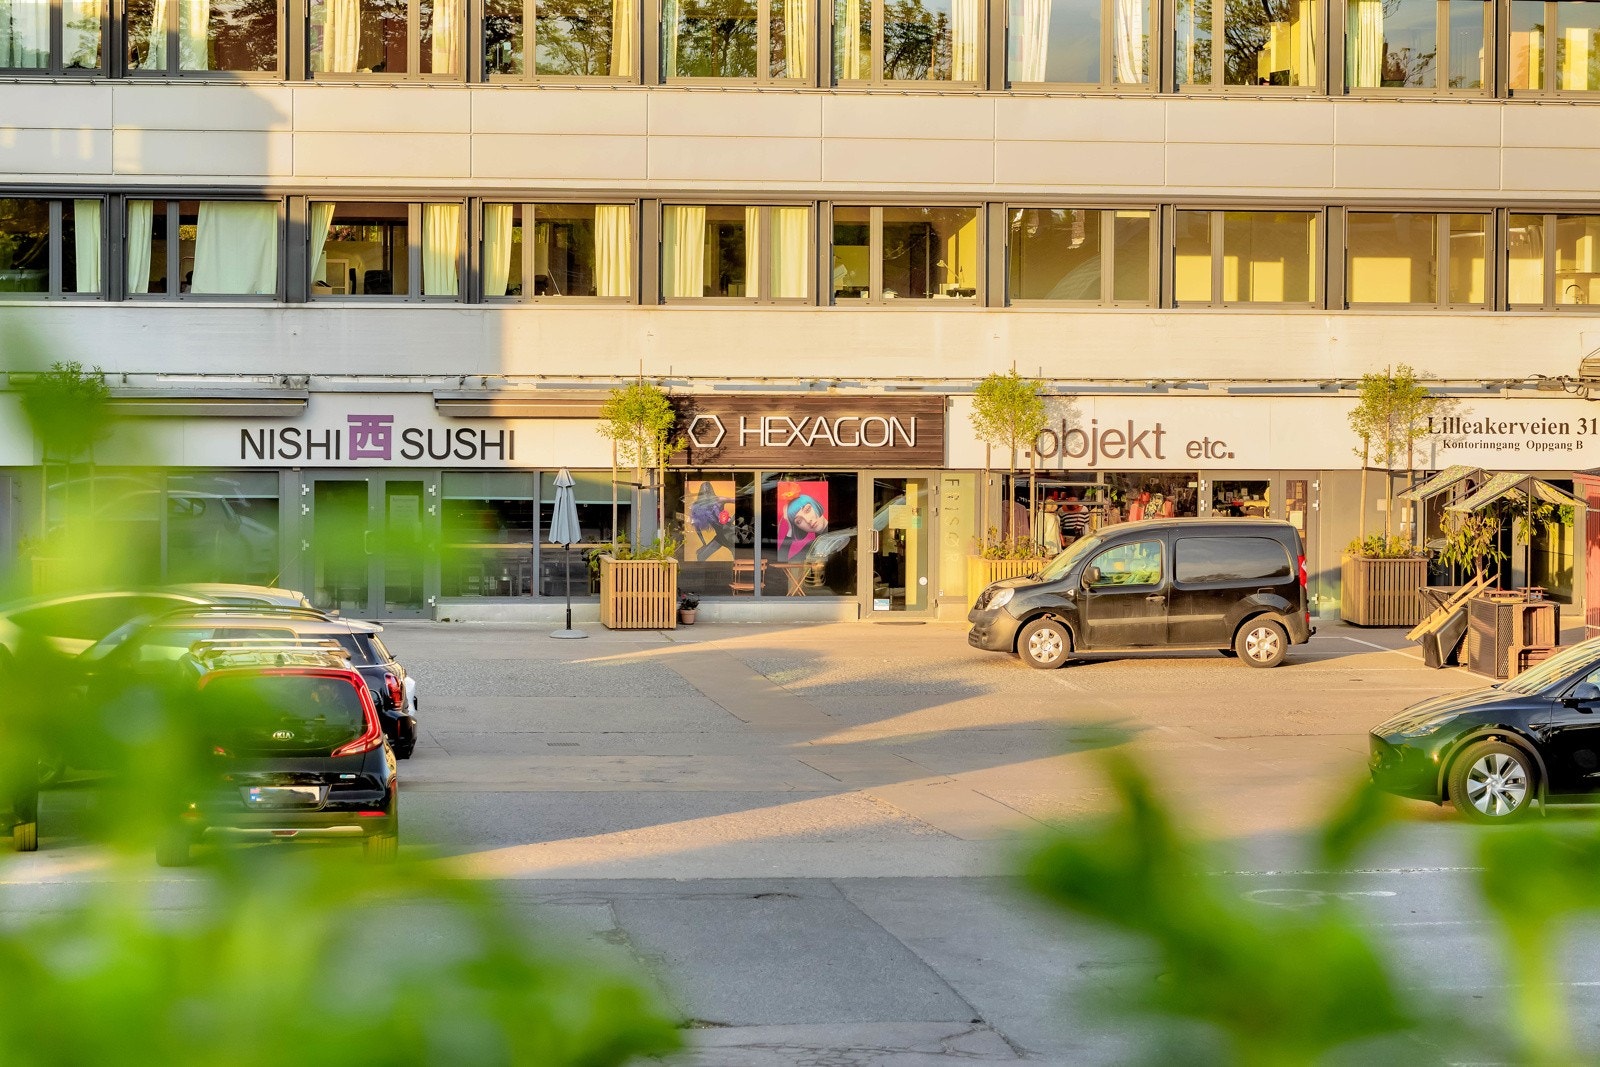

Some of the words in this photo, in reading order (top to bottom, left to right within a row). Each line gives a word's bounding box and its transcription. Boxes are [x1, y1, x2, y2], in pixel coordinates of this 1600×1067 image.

[739, 415, 916, 448] HEXAGON
[1427, 416, 1570, 435] Lilleakerveien
[1576, 417, 1598, 435] 31
[240, 427, 341, 460] NISHI
[347, 414, 394, 461] 西
[400, 427, 515, 460] SUSHI
[1185, 436, 1236, 459] etc.
[1443, 440, 1520, 450] Kontorinngang
[1526, 440, 1573, 451] Oppgang
[1576, 441, 1583, 449] B
[275, 731, 293, 740] KIA
